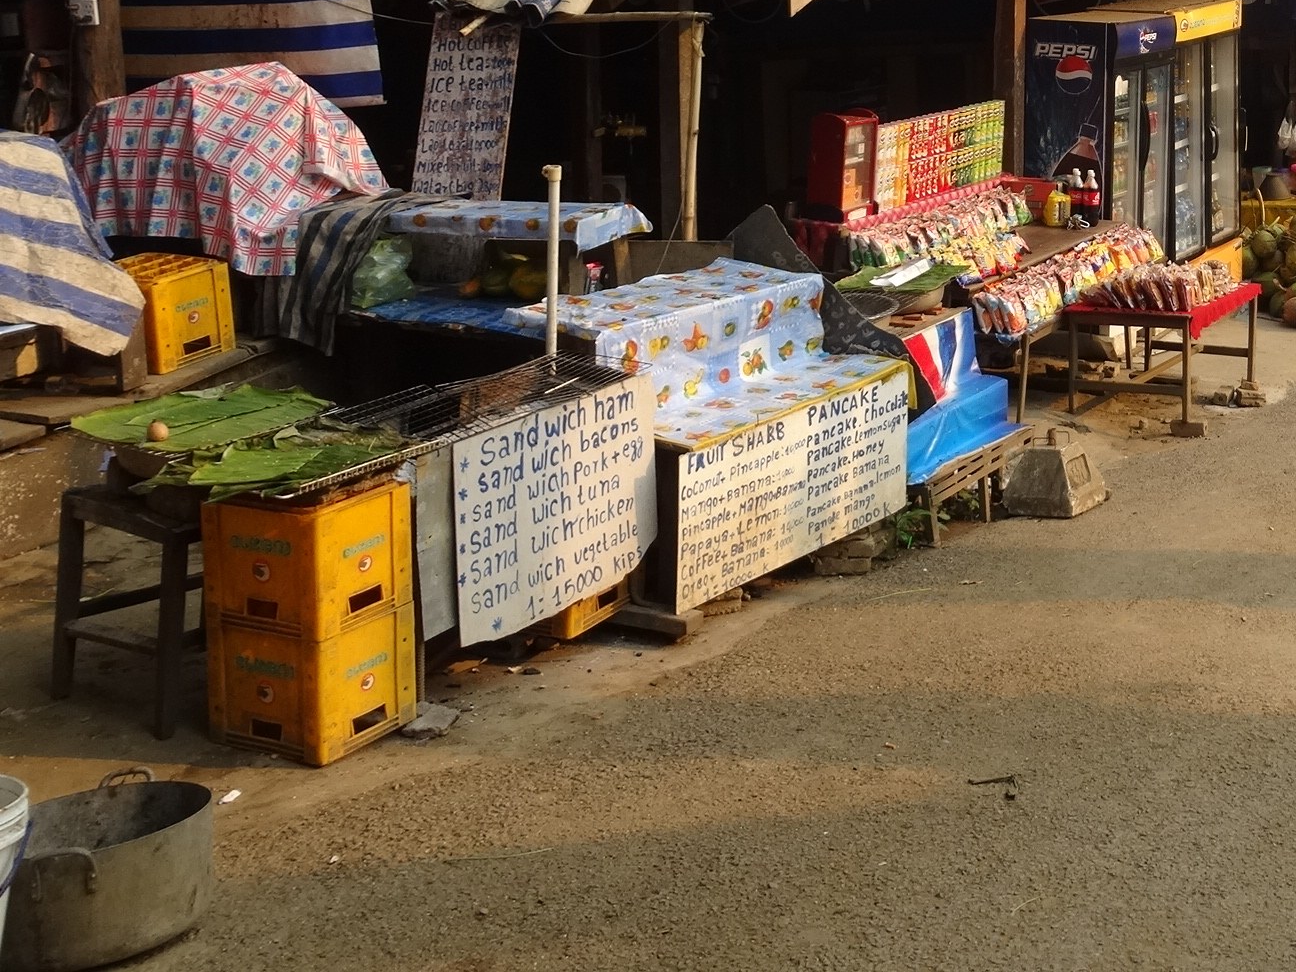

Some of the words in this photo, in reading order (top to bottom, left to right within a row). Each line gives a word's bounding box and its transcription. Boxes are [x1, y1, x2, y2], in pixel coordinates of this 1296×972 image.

[432, 56, 454, 73] Hot
[1034, 42, 1098, 60] PEPSI
[544, 398, 588, 439] wich
[593, 389, 636, 424] ham
[806, 385, 880, 427] PANCAKE
[477, 451, 526, 494] sand
[531, 439, 573, 475] wich
[579, 416, 640, 454] bacons
[687, 439, 730, 475] FRUIT
[807, 471, 849, 501] Pancake
[852, 453, 890, 480] Banana
[531, 490, 573, 525] wich
[577, 474, 621, 505] tuna
[806, 495, 841, 519] Pancake
[527, 554, 566, 588] wich
[573, 518, 640, 566] vegetable
[550, 564, 604, 608] 15000
[612, 544, 644, 577] kips
